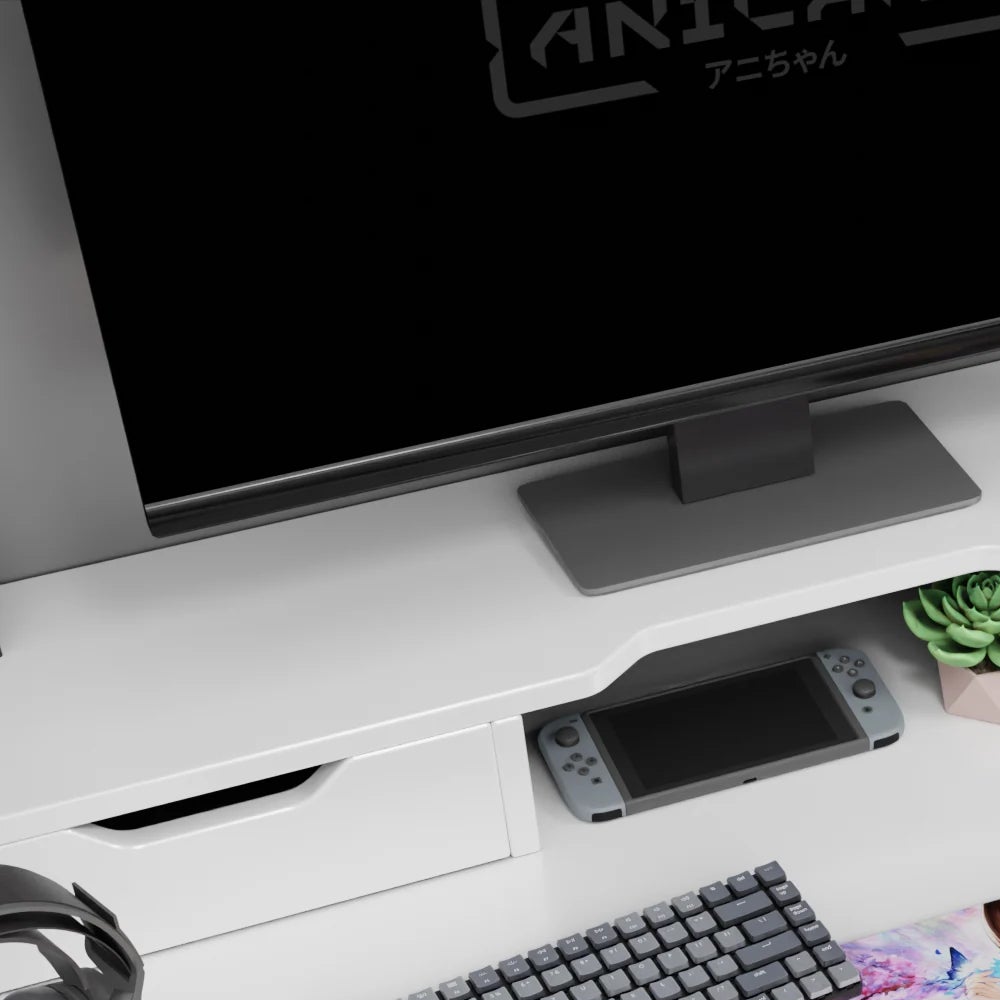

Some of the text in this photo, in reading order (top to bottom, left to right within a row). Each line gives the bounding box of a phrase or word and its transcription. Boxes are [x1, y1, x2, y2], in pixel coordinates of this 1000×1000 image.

[705, 40, 847, 89] アニちゃん
